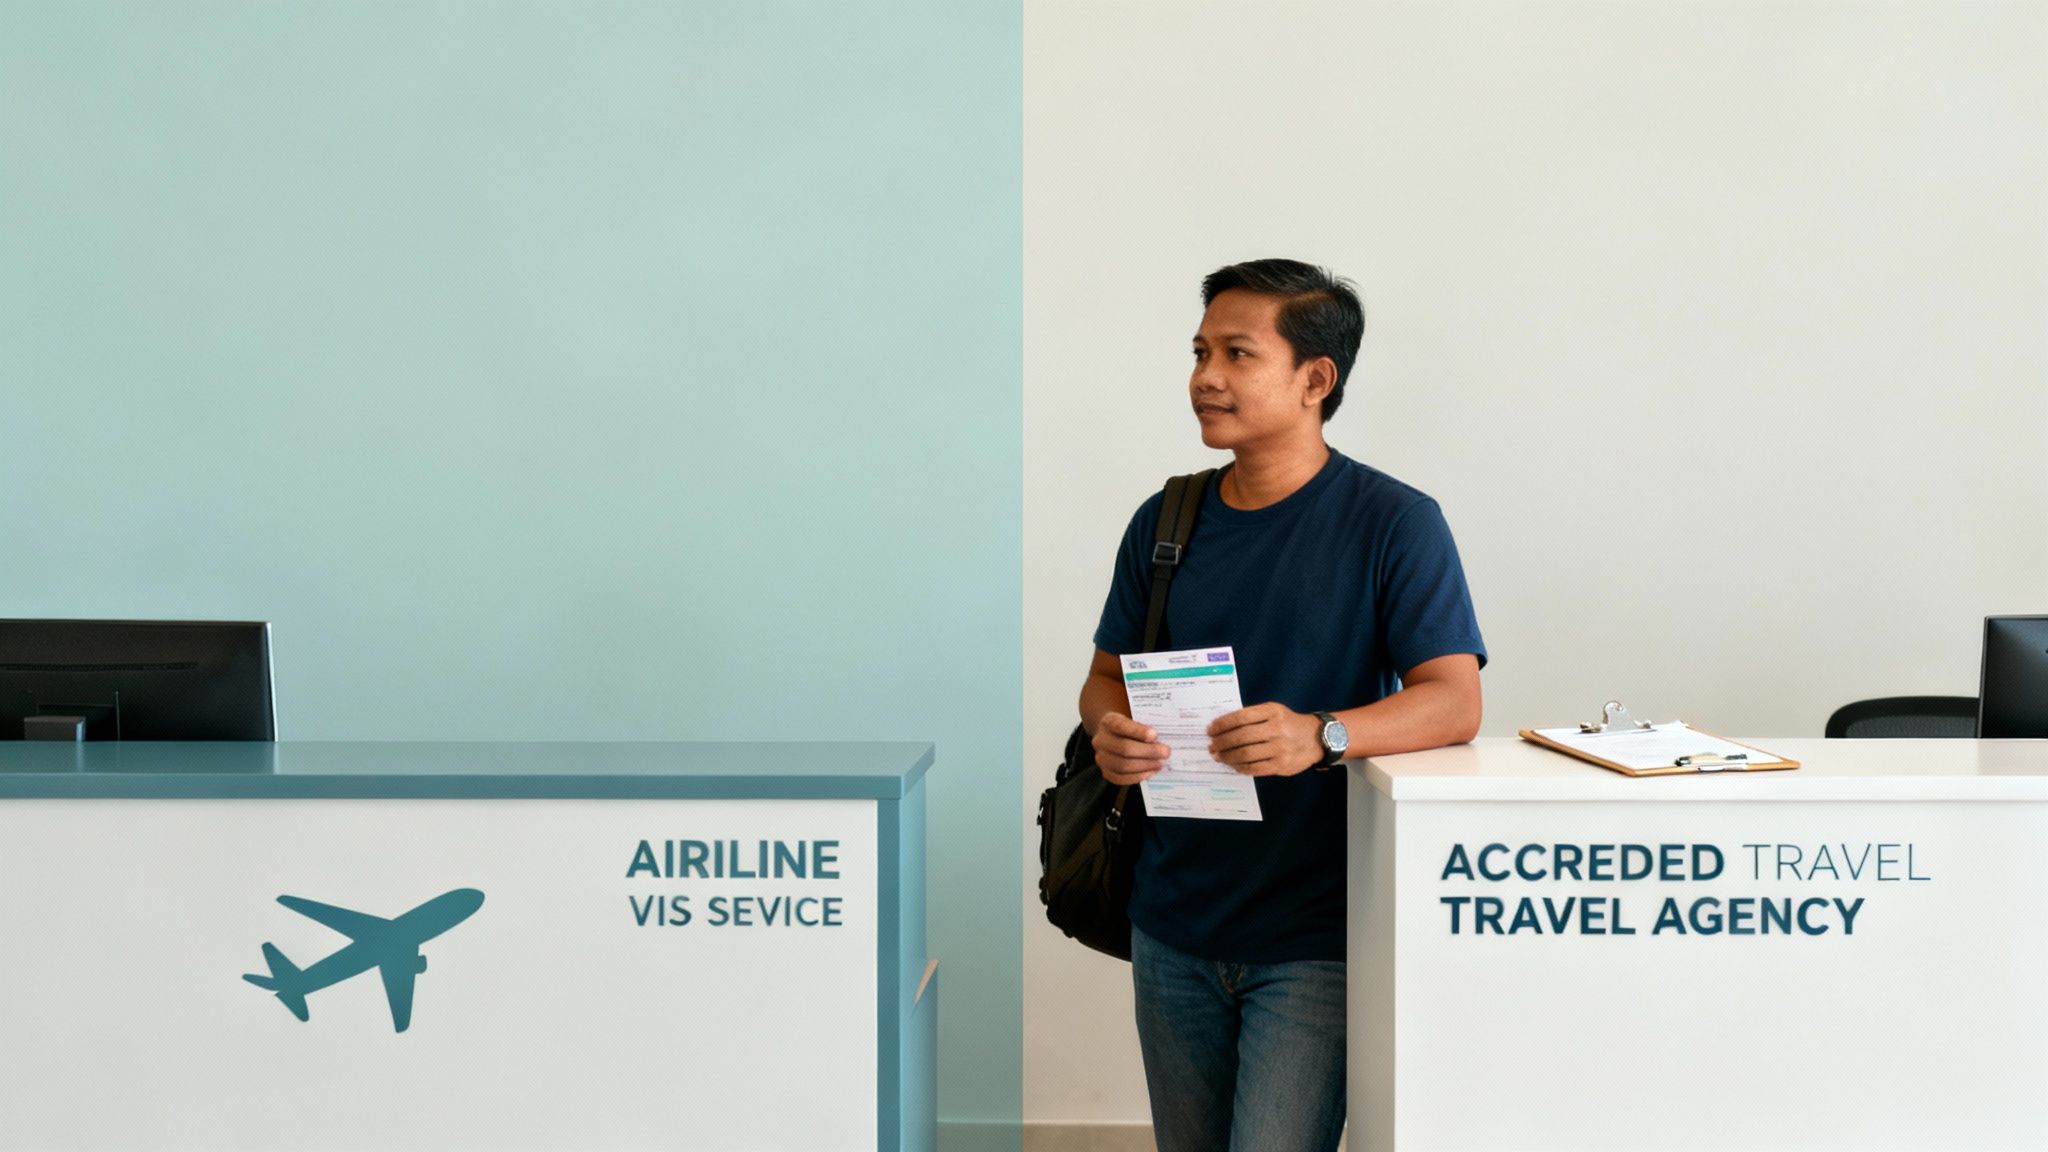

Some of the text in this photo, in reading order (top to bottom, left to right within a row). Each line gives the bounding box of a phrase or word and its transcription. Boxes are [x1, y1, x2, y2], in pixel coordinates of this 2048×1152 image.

[625, 840, 841, 880] AIRILINE
[1440, 843, 1932, 882] ACCREDED TRAVEL
[628, 895, 844, 927] VIS SEVICE
[1439, 896, 1866, 937] TRAVEL AGENCY
